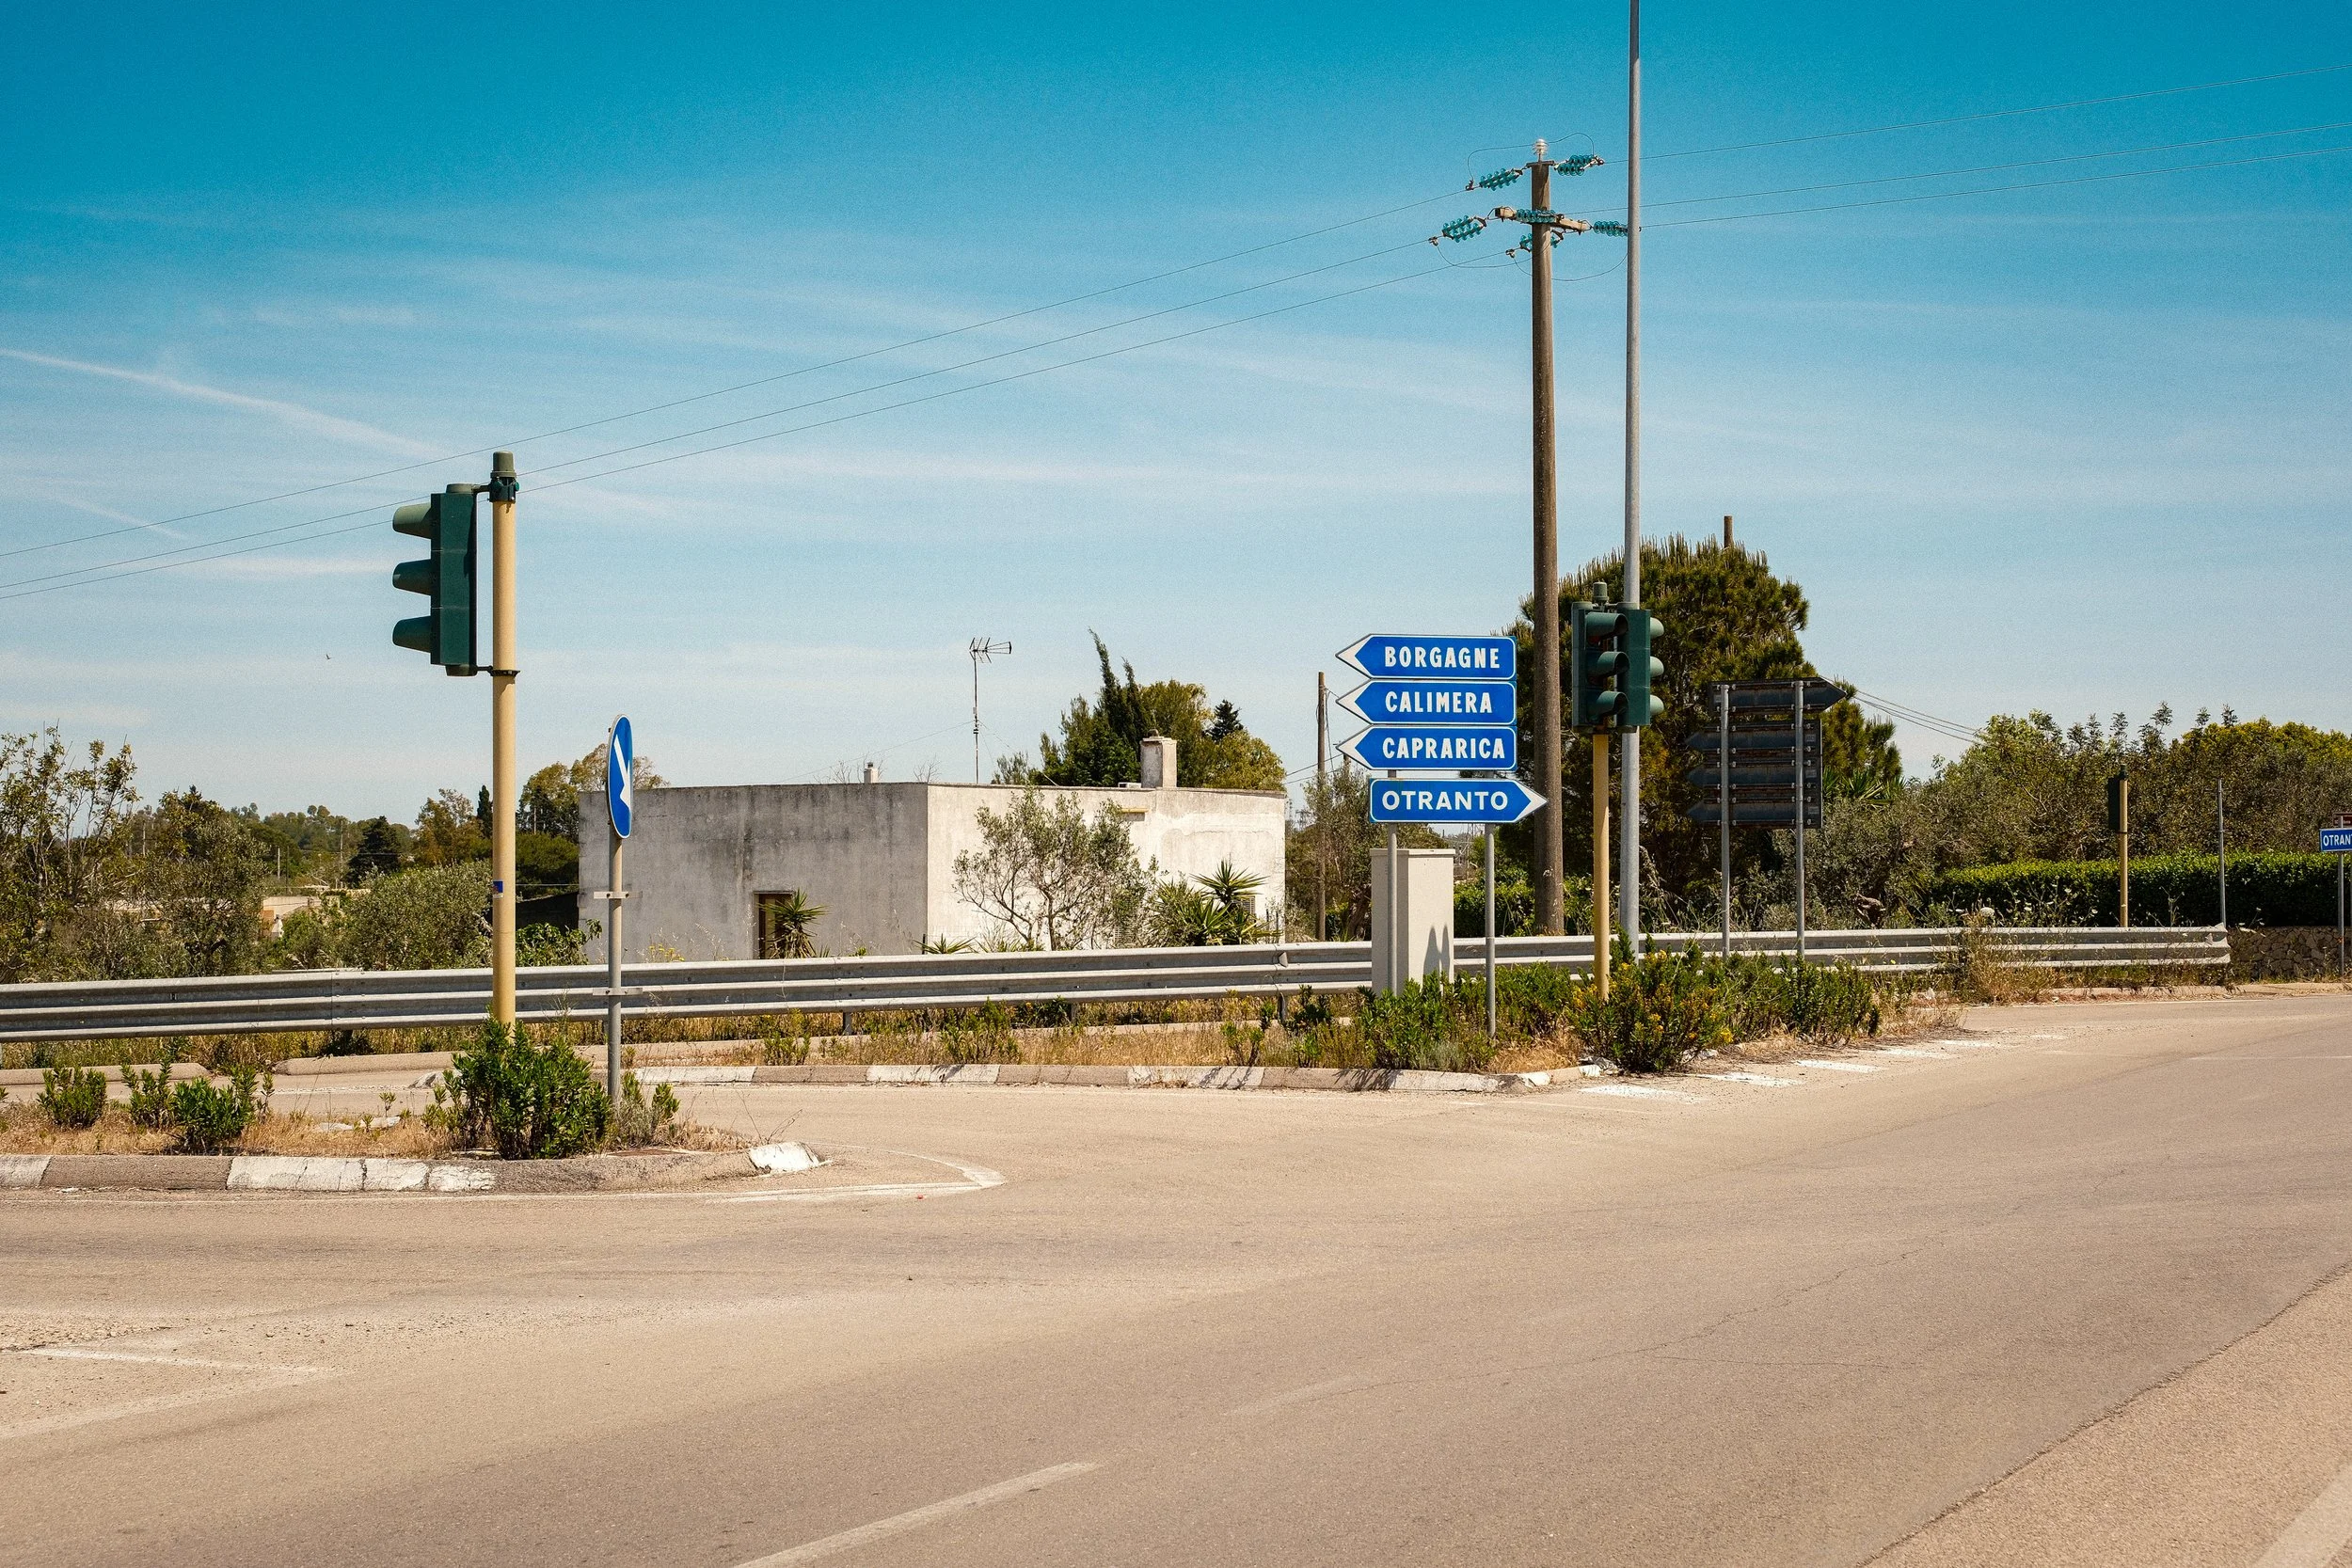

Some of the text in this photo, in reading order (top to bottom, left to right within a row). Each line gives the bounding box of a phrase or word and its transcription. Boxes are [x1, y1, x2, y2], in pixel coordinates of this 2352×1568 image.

[1384, 646, 1501, 669] BORGAGNE
[1385, 691, 1493, 714] CALIMERA
[1382, 737, 1505, 759] CAPRARICA
[1381, 790, 1508, 811] OTRANTO
[2323, 834, 2352, 847] OTRAN
